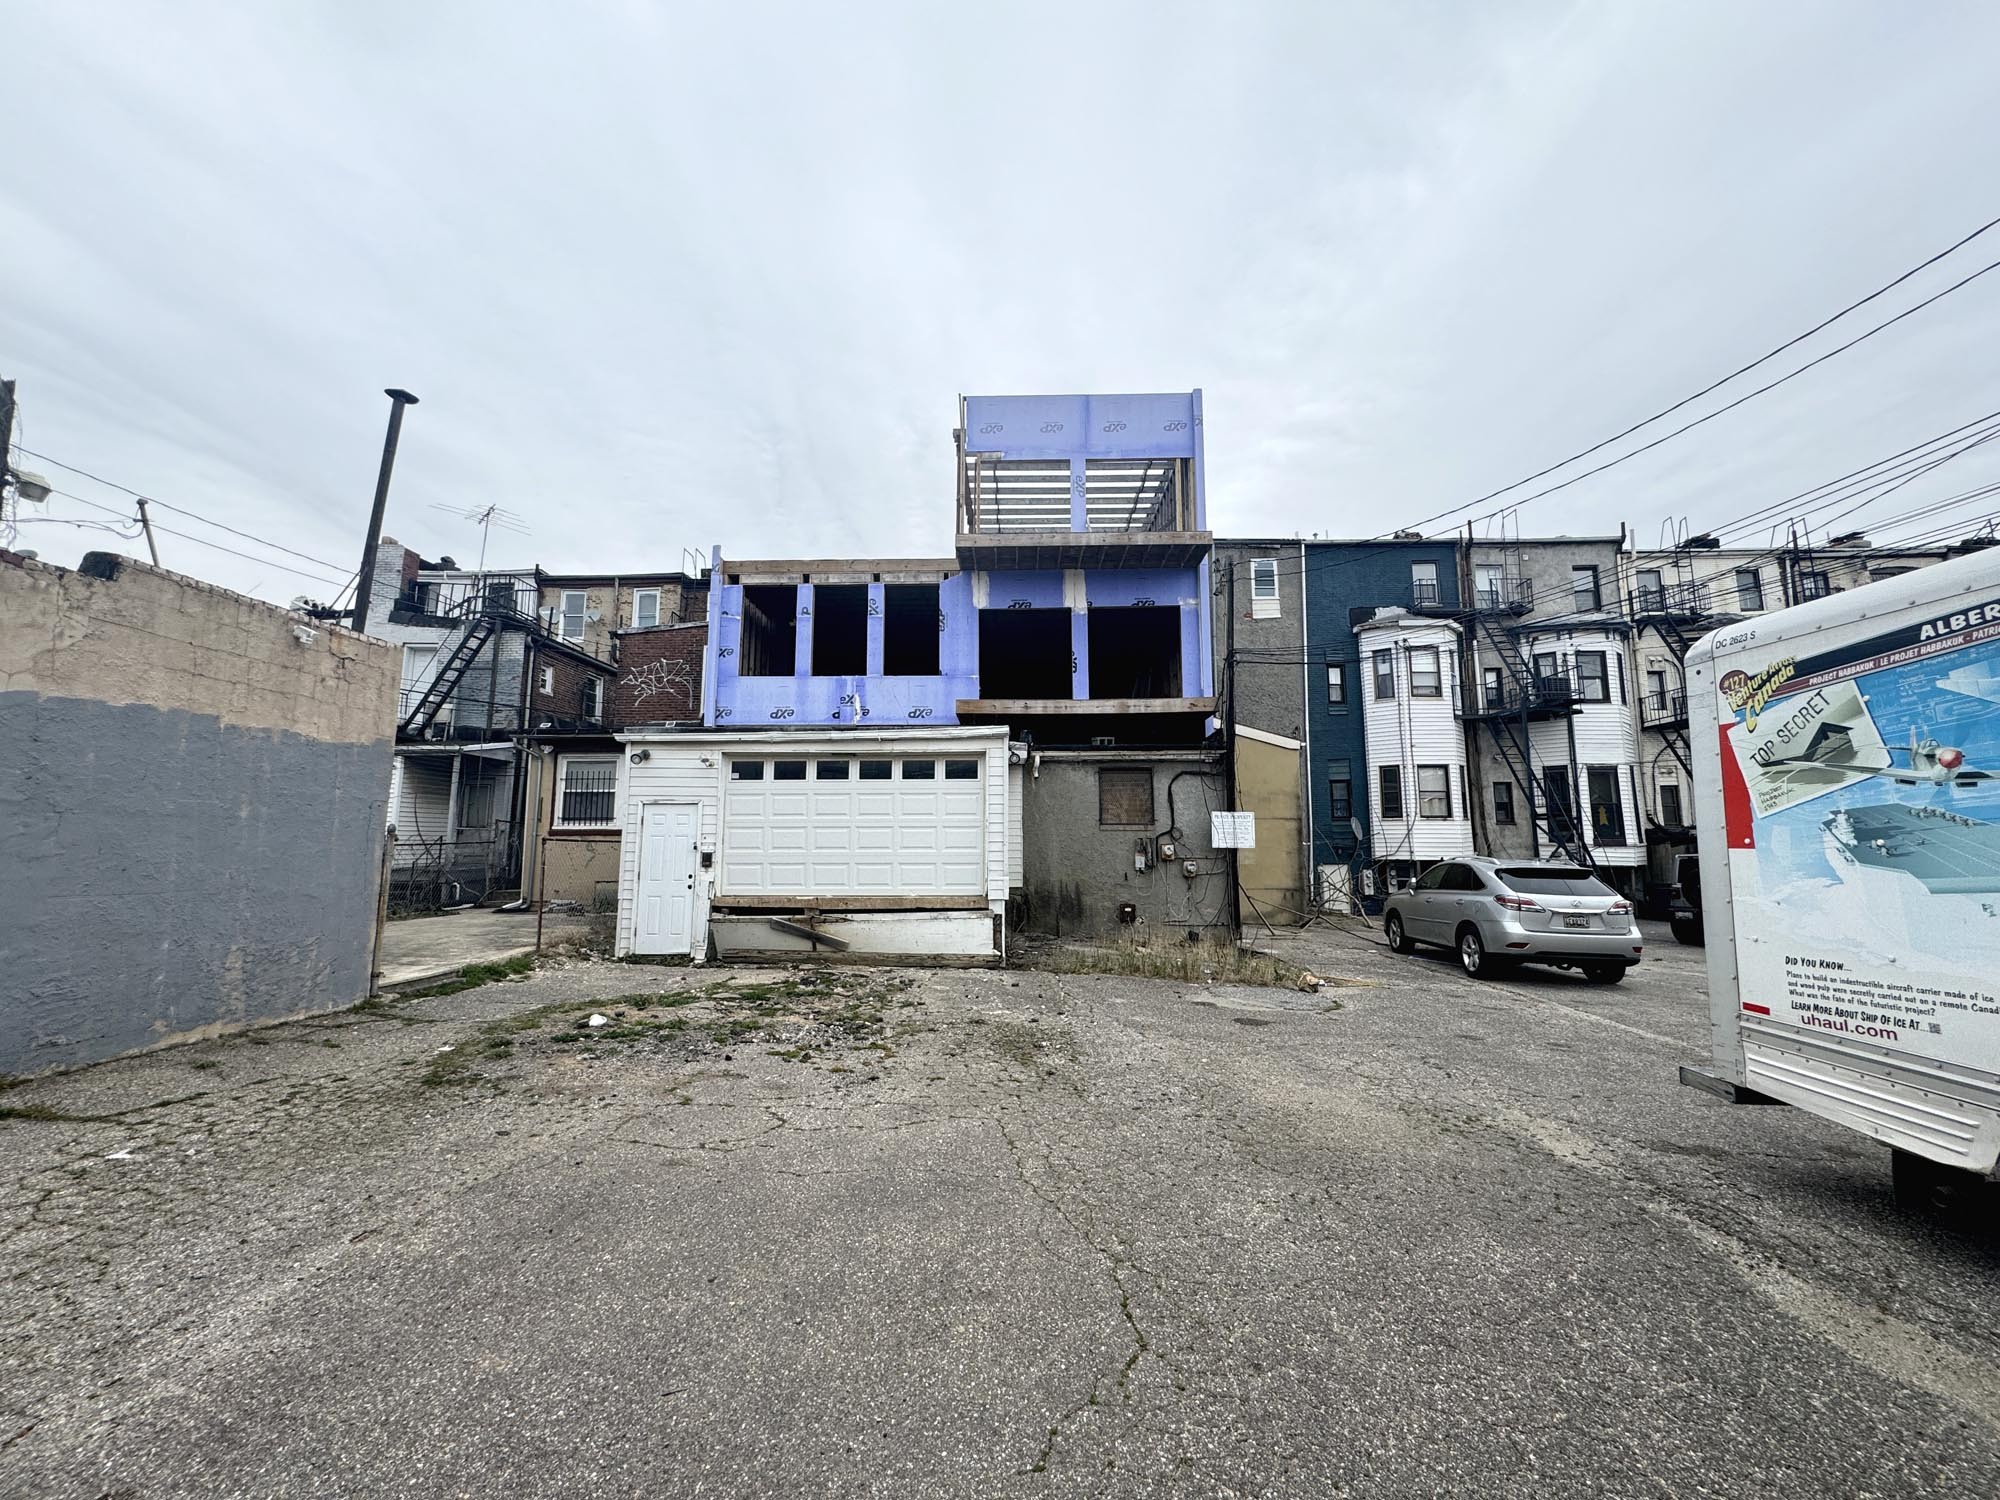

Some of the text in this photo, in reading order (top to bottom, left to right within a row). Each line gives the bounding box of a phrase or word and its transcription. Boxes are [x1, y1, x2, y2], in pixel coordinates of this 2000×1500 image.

[1920, 603, 2000, 640] ALBER
[1715, 630, 1756, 650] DC 2623 S
[1808, 672, 1837, 686] PROJECT
[1838, 660, 1875, 678] HABBAKUK
[1880, 656, 1890, 666] LE
[1890, 648, 1919, 664] PROJET
[1920, 636, 1965, 655] HABBAKUK
[1723, 674, 1745, 691] #127
[1726, 671, 1768, 713] Venture
[1745, 664, 1795, 733] Canada
[1749, 689, 1830, 767] TOP SECRET
[1785, 955, 1798, 966] DID
[1800, 957, 1817, 968] YOU
[1786, 970, 1803, 979] Plans
[1804, 972, 1811, 980] to
[1812, 972, 1828, 982] build
[1839, 977, 1885, 989] indestructible
[1887, 982, 1914, 993] aircraft
[1916, 987, 1942, 996] carrier
[1944, 990, 1967, 999] made
[1969, 992, 1979, 1001] of
[1981, 994, 1995, 1003] ice
[1789, 988, 1805, 997] What
[1820, 992, 1830, 1000] the
[1832, 994, 1846, 1003] fate
[1847, 997, 1855, 1005] of
[1857, 998, 1868, 1006] the
[1870, 999, 1903, 1012] futuristic
[1904, 1006, 1936, 1017] project?
[1800, 981, 1815, 989] wood
[1817, 982, 1830, 992] pulp
[1849, 988, 1875, 999] secretly
[1877, 992, 1902, 1002] carried
[1904, 996, 1917, 1004] out
[1940, 1001, 1969, 1010] remote
[1971, 1003, 2000, 1015] Canad
[1801, 1013, 1898, 1041] uhaul.com
